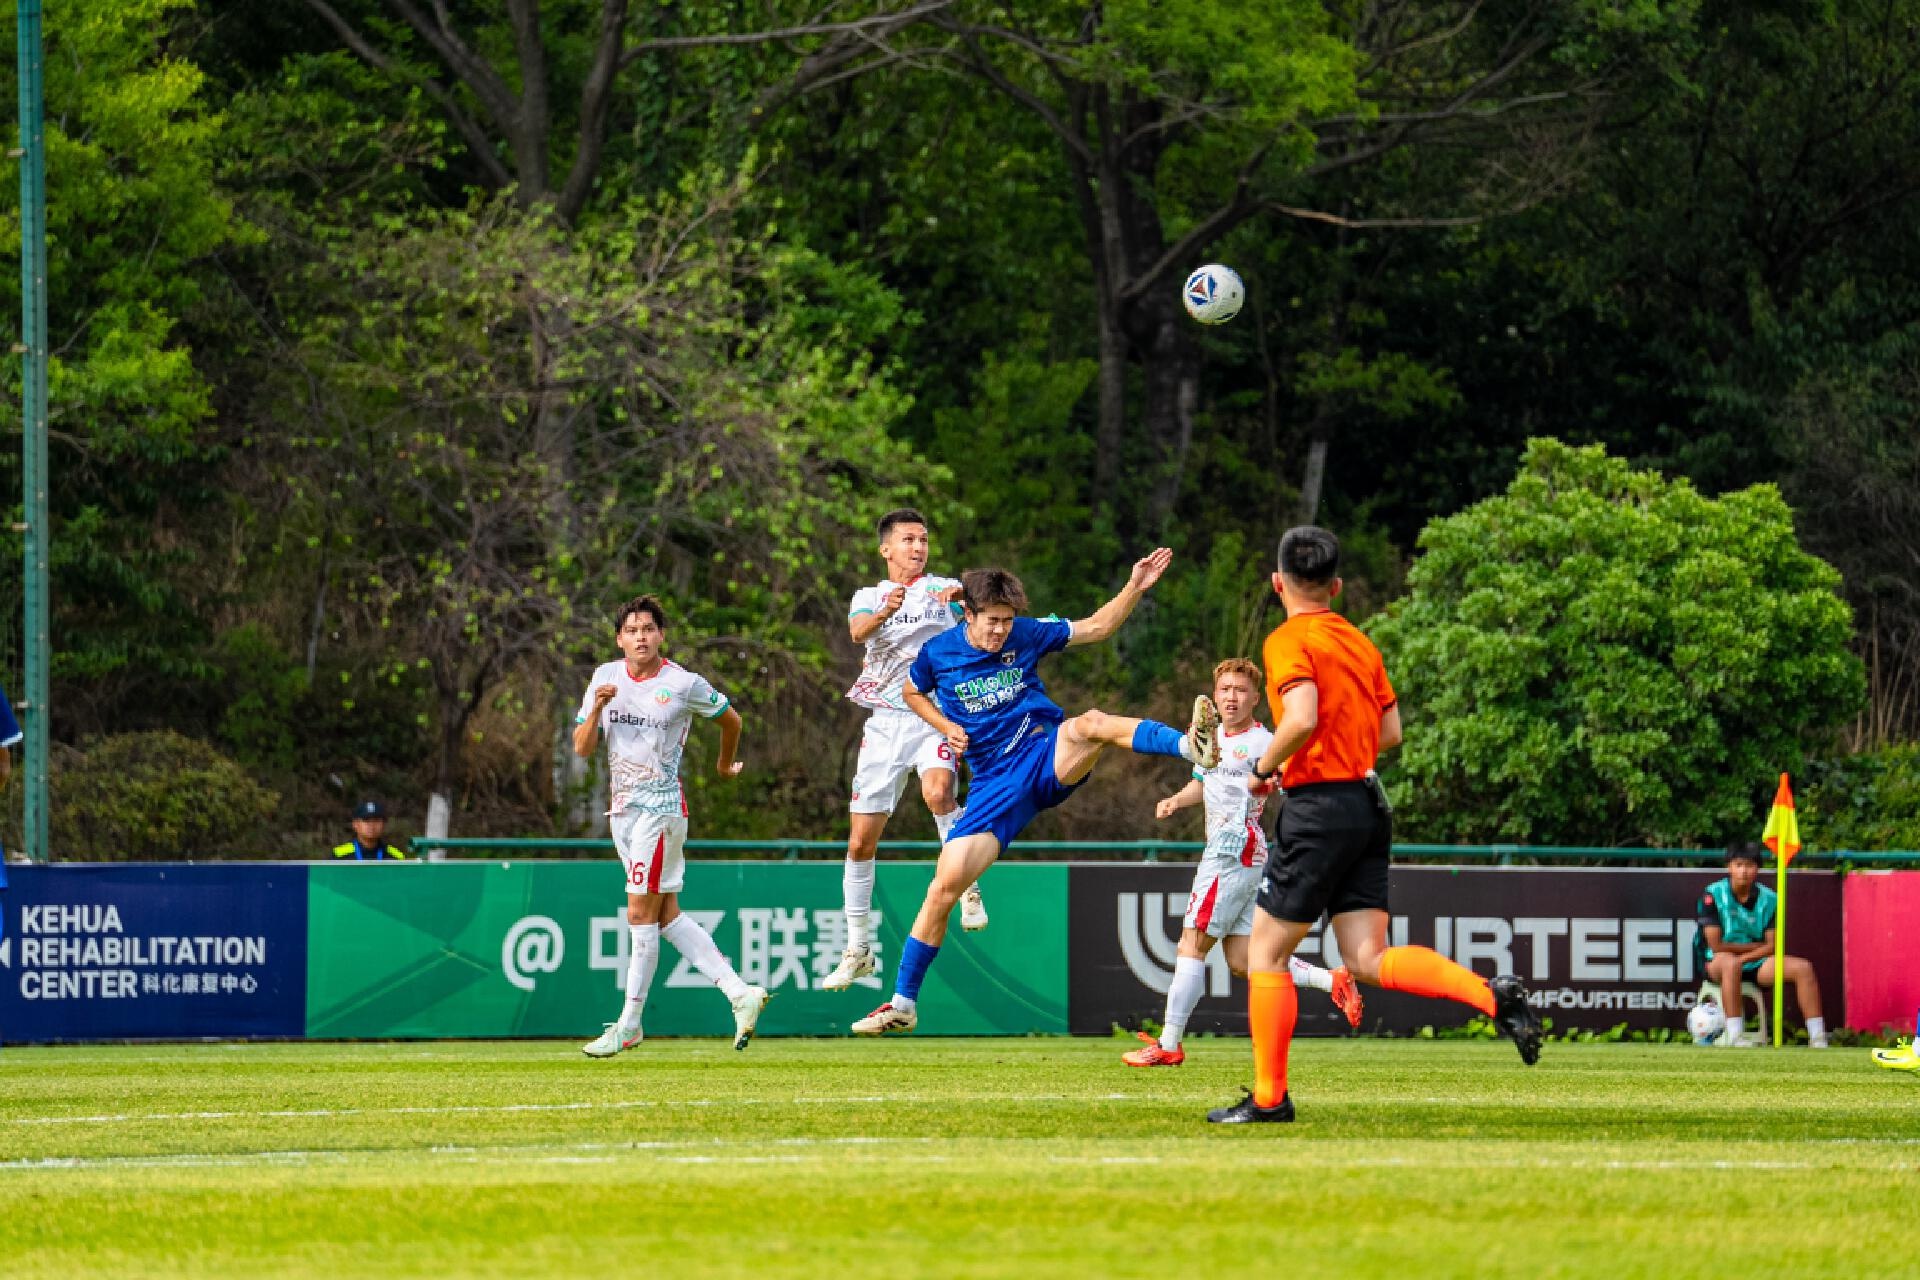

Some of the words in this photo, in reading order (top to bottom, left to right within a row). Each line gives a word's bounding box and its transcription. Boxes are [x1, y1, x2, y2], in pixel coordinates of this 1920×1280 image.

[21, 904, 124, 934] KEHUA
[21, 936, 266, 966] REHABILITATION
[20, 969, 138, 1000] CENTER
[142, 972, 259, 995] 科化康复中心
